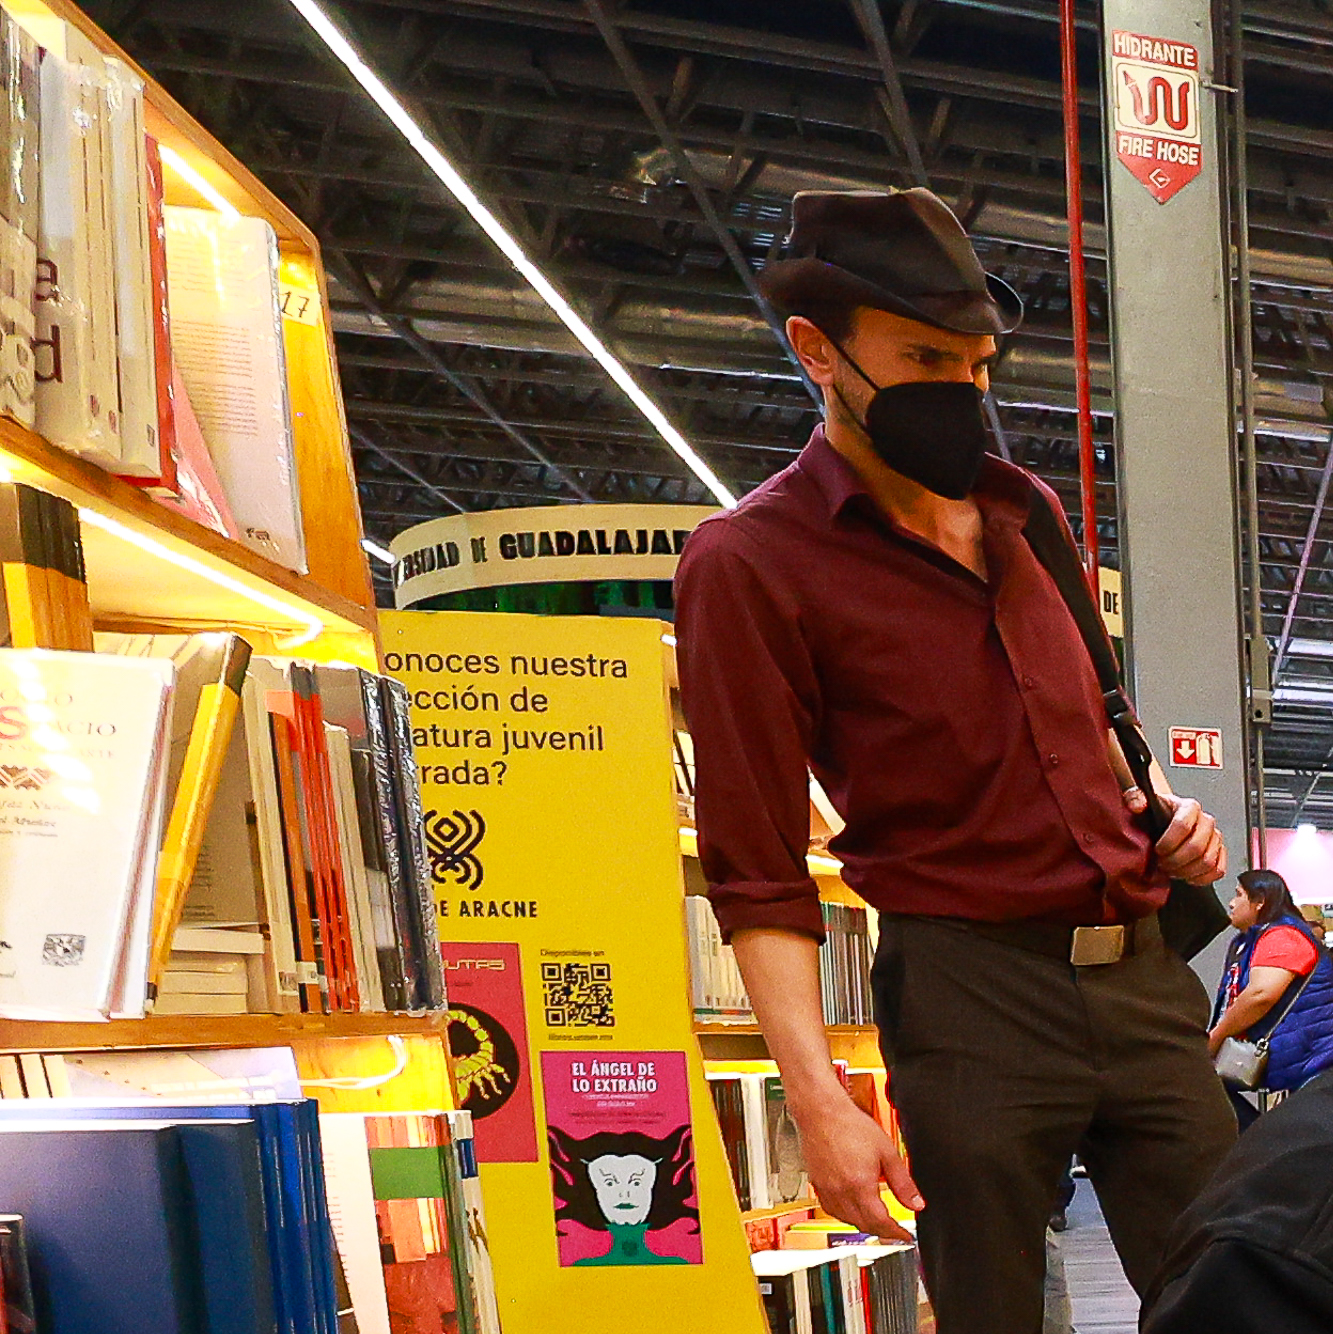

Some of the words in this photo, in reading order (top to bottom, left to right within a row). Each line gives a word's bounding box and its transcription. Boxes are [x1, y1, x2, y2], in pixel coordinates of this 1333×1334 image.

[1114, 34, 1196, 66] HIDRANTE
[1119, 136, 1153, 157] FIRE
[1157, 142, 1199, 165] HOSE
[281, 290, 309, 320] 17
[384, 652, 500, 674] onoces
[510, 653, 628, 679] nuestra
[510, 686, 549, 713] de
[412, 726, 492, 749] atura
[502, 725, 604, 755] juvenil
[420, 761, 508, 785] rada?
[459, 900, 538, 918] ARACNE
[572, 1062, 588, 1076] EL
[591, 1059, 635, 1077] ÁNGEL
[638, 1062, 655, 1077] DE
[572, 1078, 591, 1092] LO
[594, 1075, 657, 1093] EXTRAÑO
